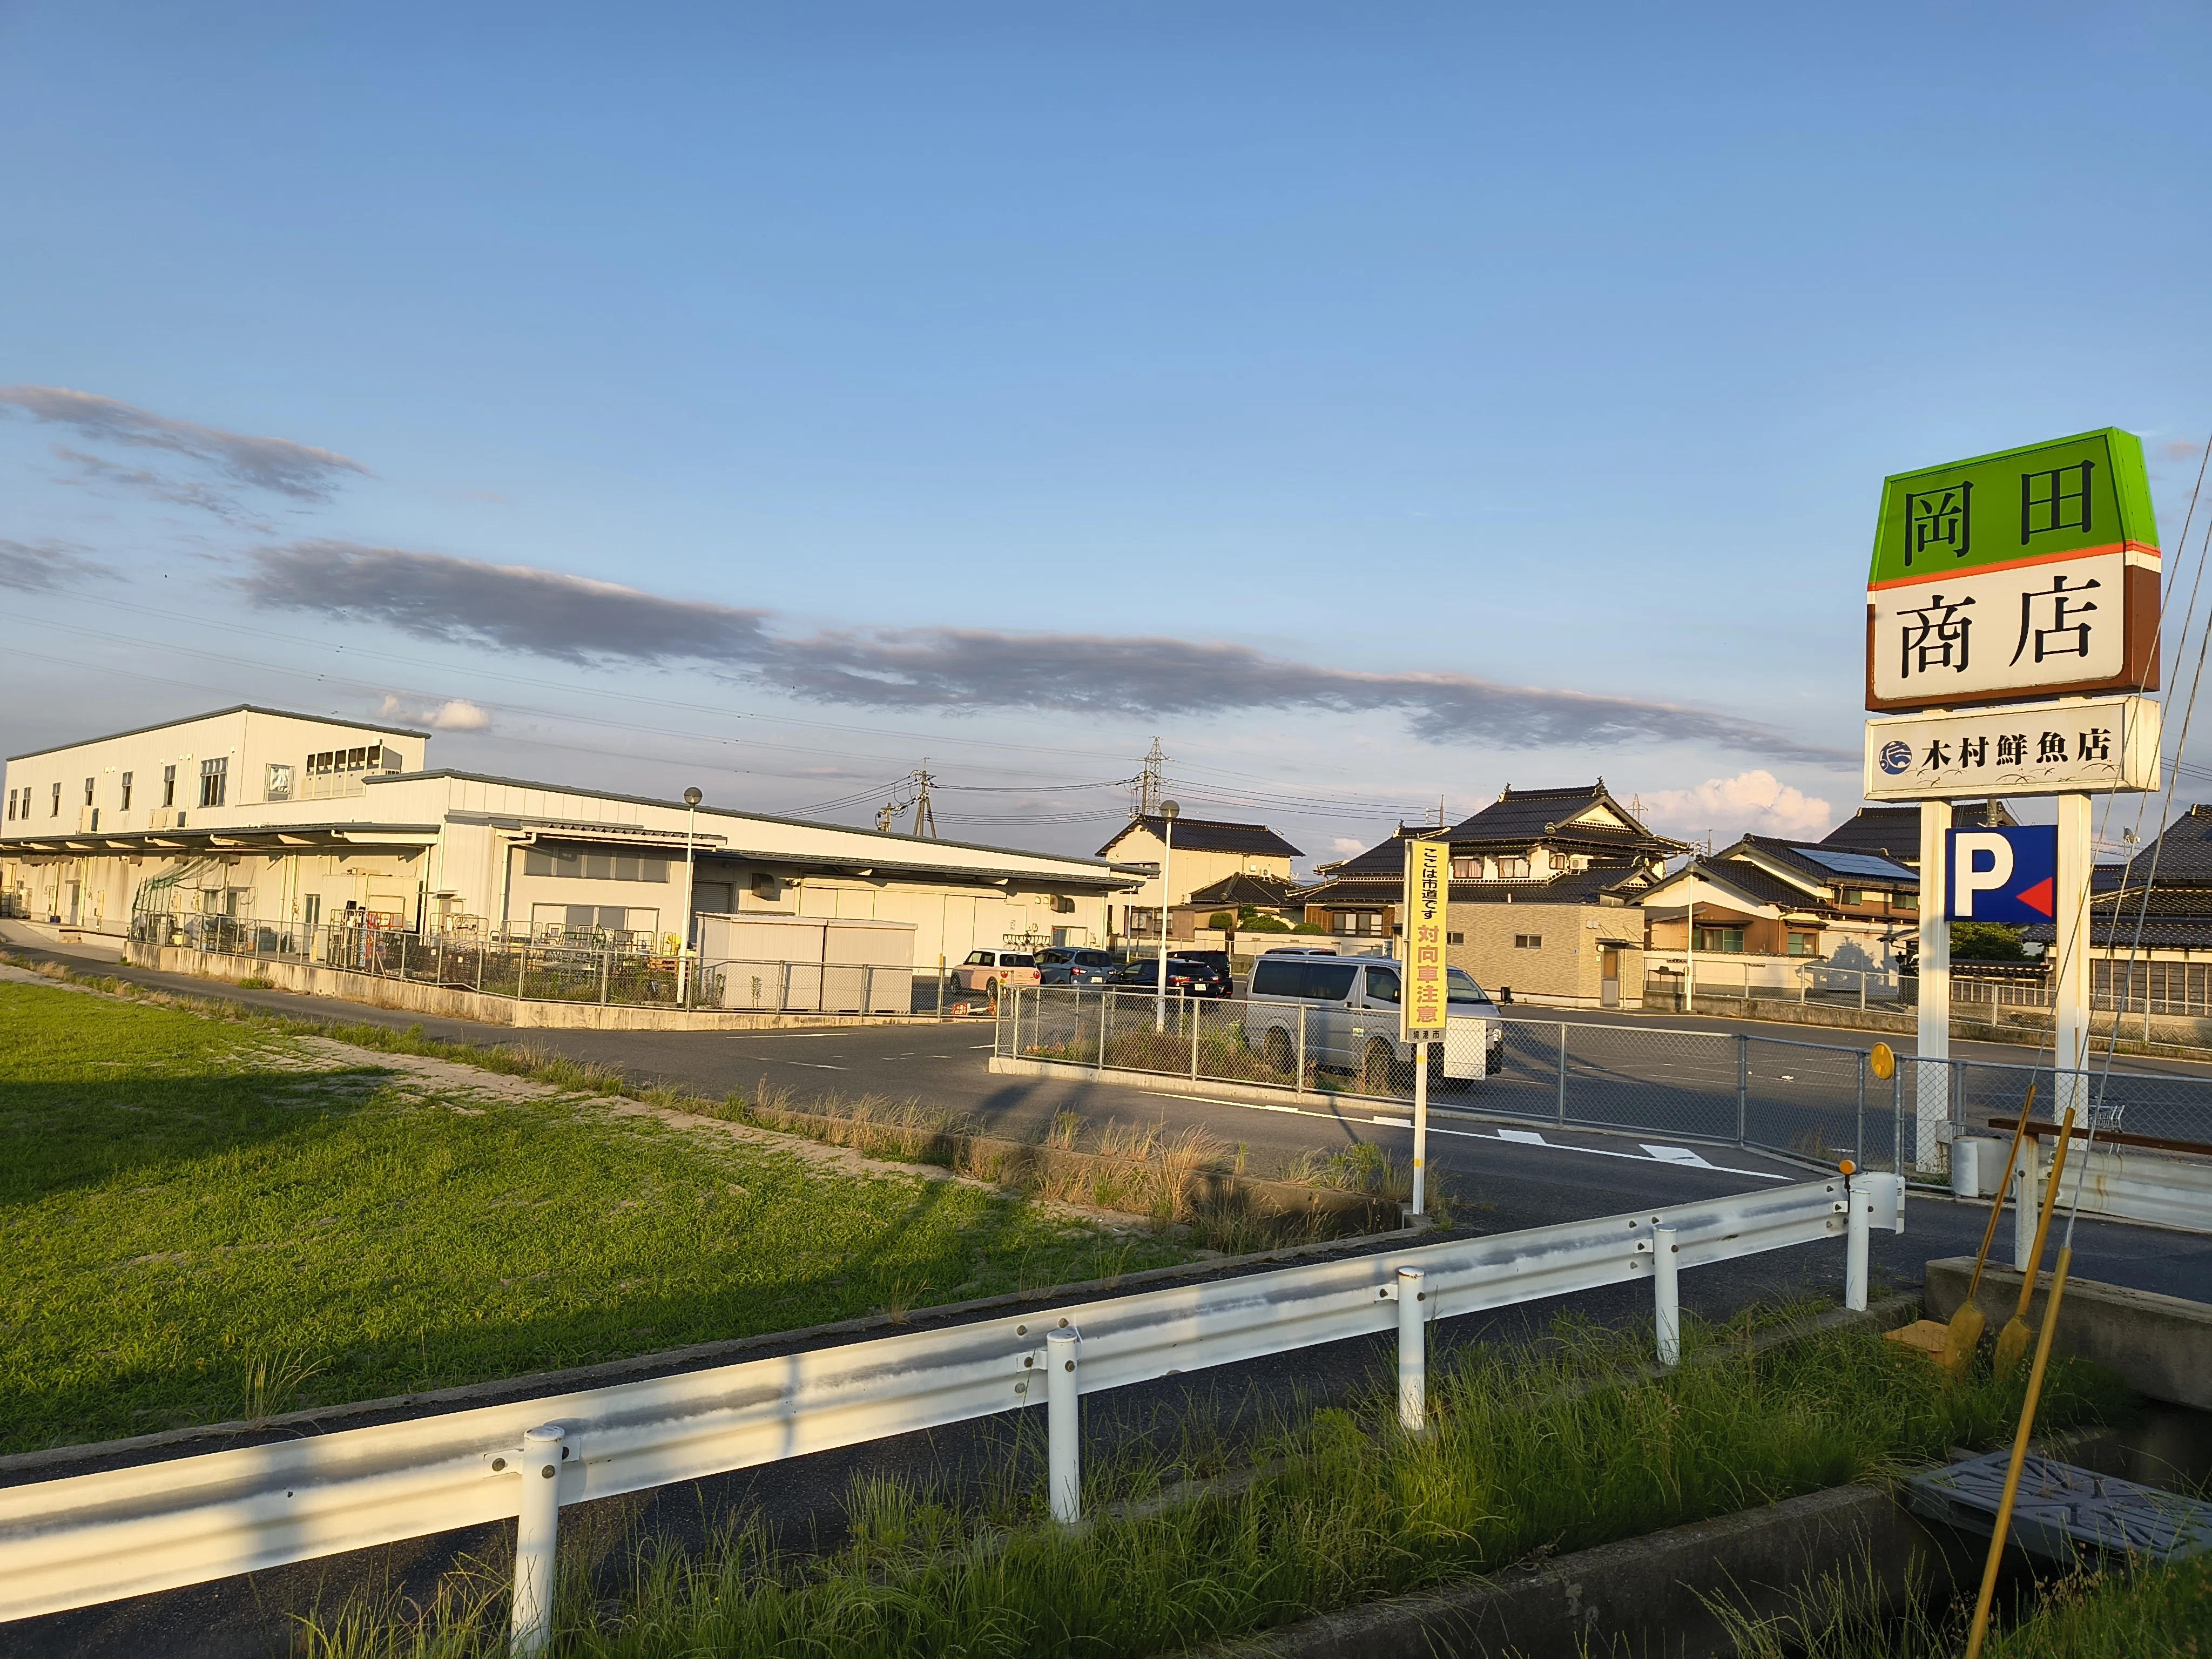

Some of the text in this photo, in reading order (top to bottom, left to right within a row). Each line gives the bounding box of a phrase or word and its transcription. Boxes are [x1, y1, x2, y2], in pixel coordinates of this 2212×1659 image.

[1904, 460, 2095, 567] 岡田
[1896, 576, 2101, 679] 商店
[1921, 728, 2112, 771] 木村鮮魚店
[1421, 848, 1438, 920] ここは市道です
[1954, 832, 2013, 916] P
[1417, 925, 1439, 1023] 対向車注意
[1413, 1030, 1440, 1040] 境港市
